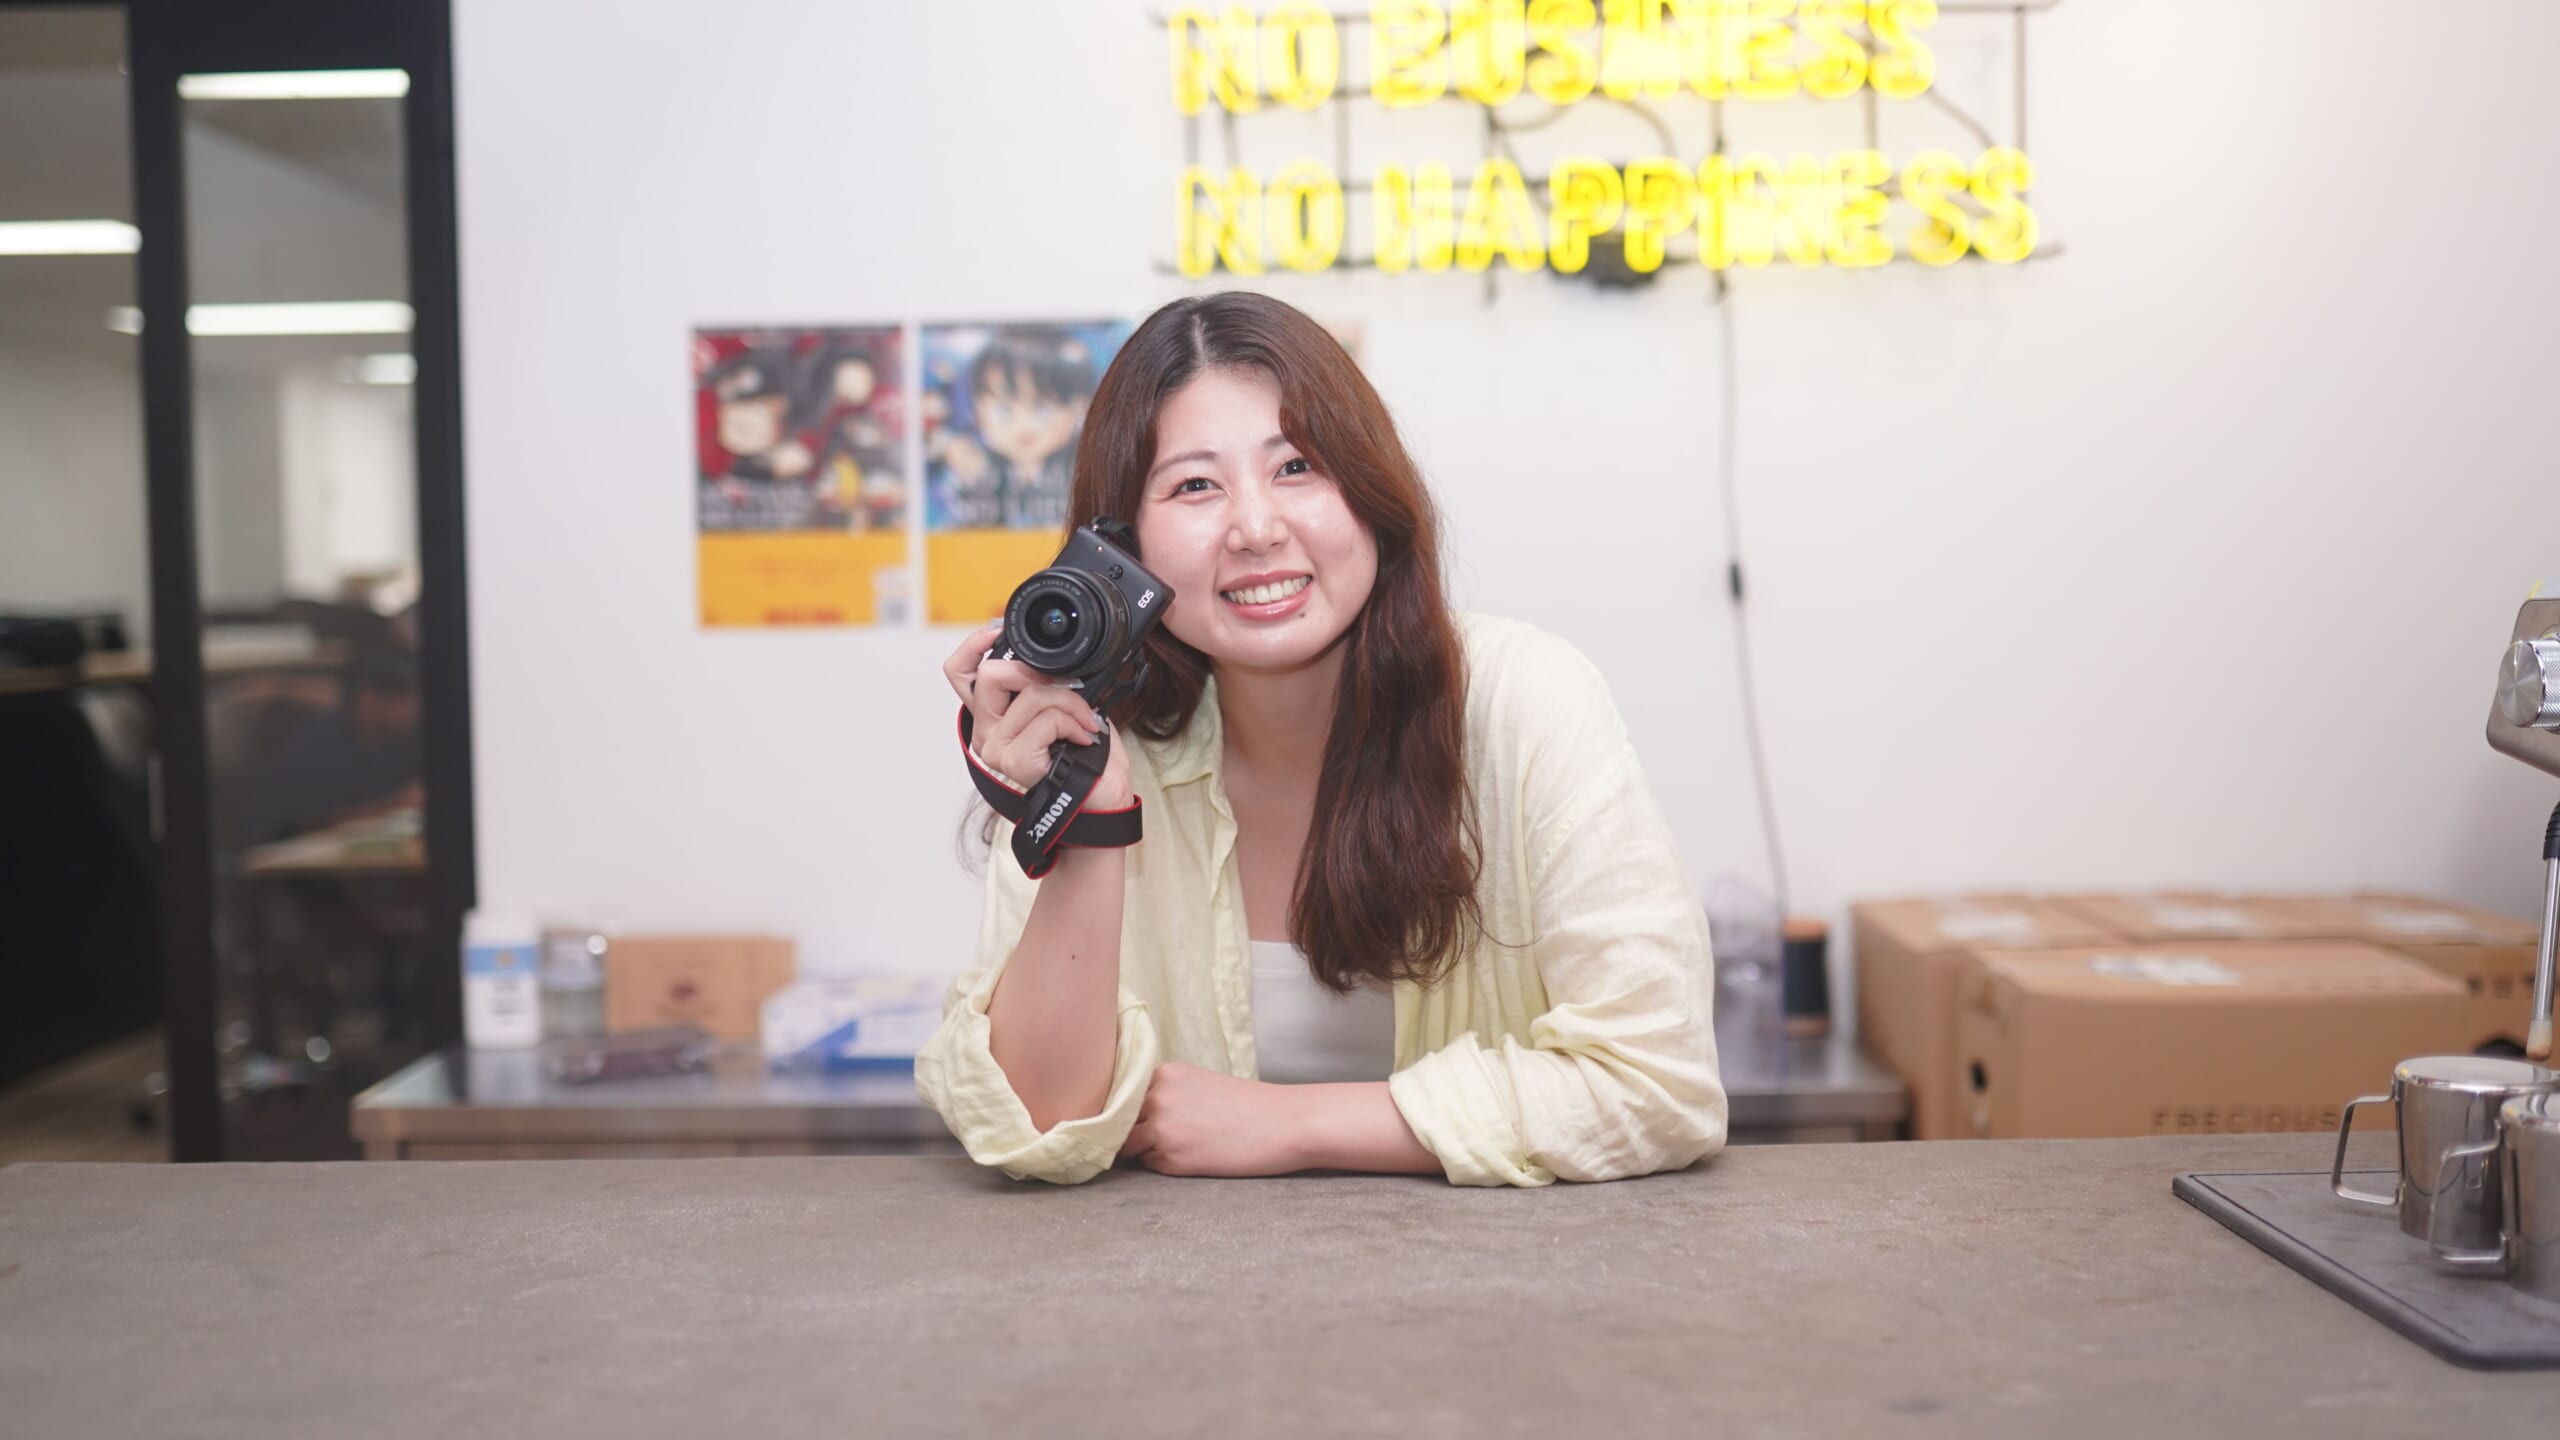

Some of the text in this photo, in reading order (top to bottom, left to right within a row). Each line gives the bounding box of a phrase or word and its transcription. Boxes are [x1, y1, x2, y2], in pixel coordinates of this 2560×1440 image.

[1169, 0, 1938, 117] NO BUSINESS
[1177, 146, 2041, 279] NO HAPPINESS
[1137, 588, 1155, 609] EOS
